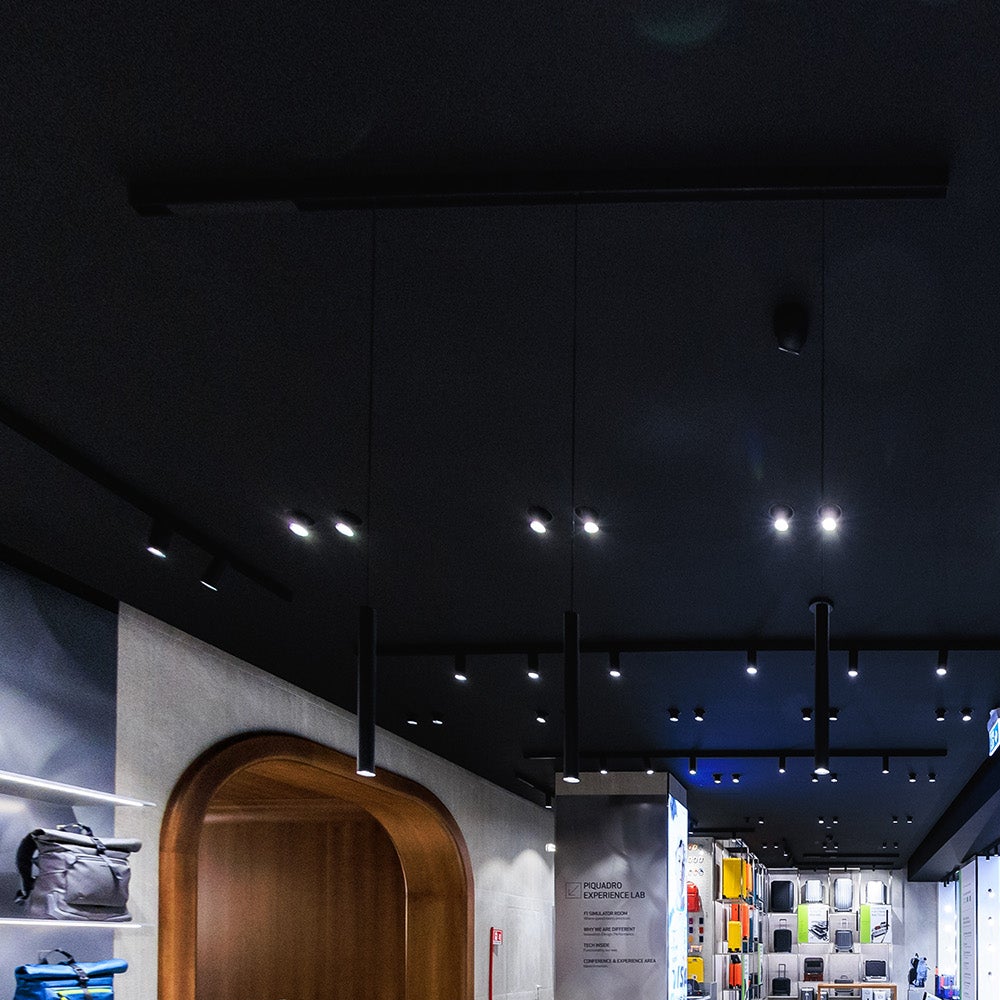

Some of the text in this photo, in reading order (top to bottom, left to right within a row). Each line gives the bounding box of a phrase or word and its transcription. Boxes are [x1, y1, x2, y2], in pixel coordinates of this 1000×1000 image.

[583, 882, 623, 890] PIQUADRO
[583, 891, 646, 899] EXPERIENCE LAB
